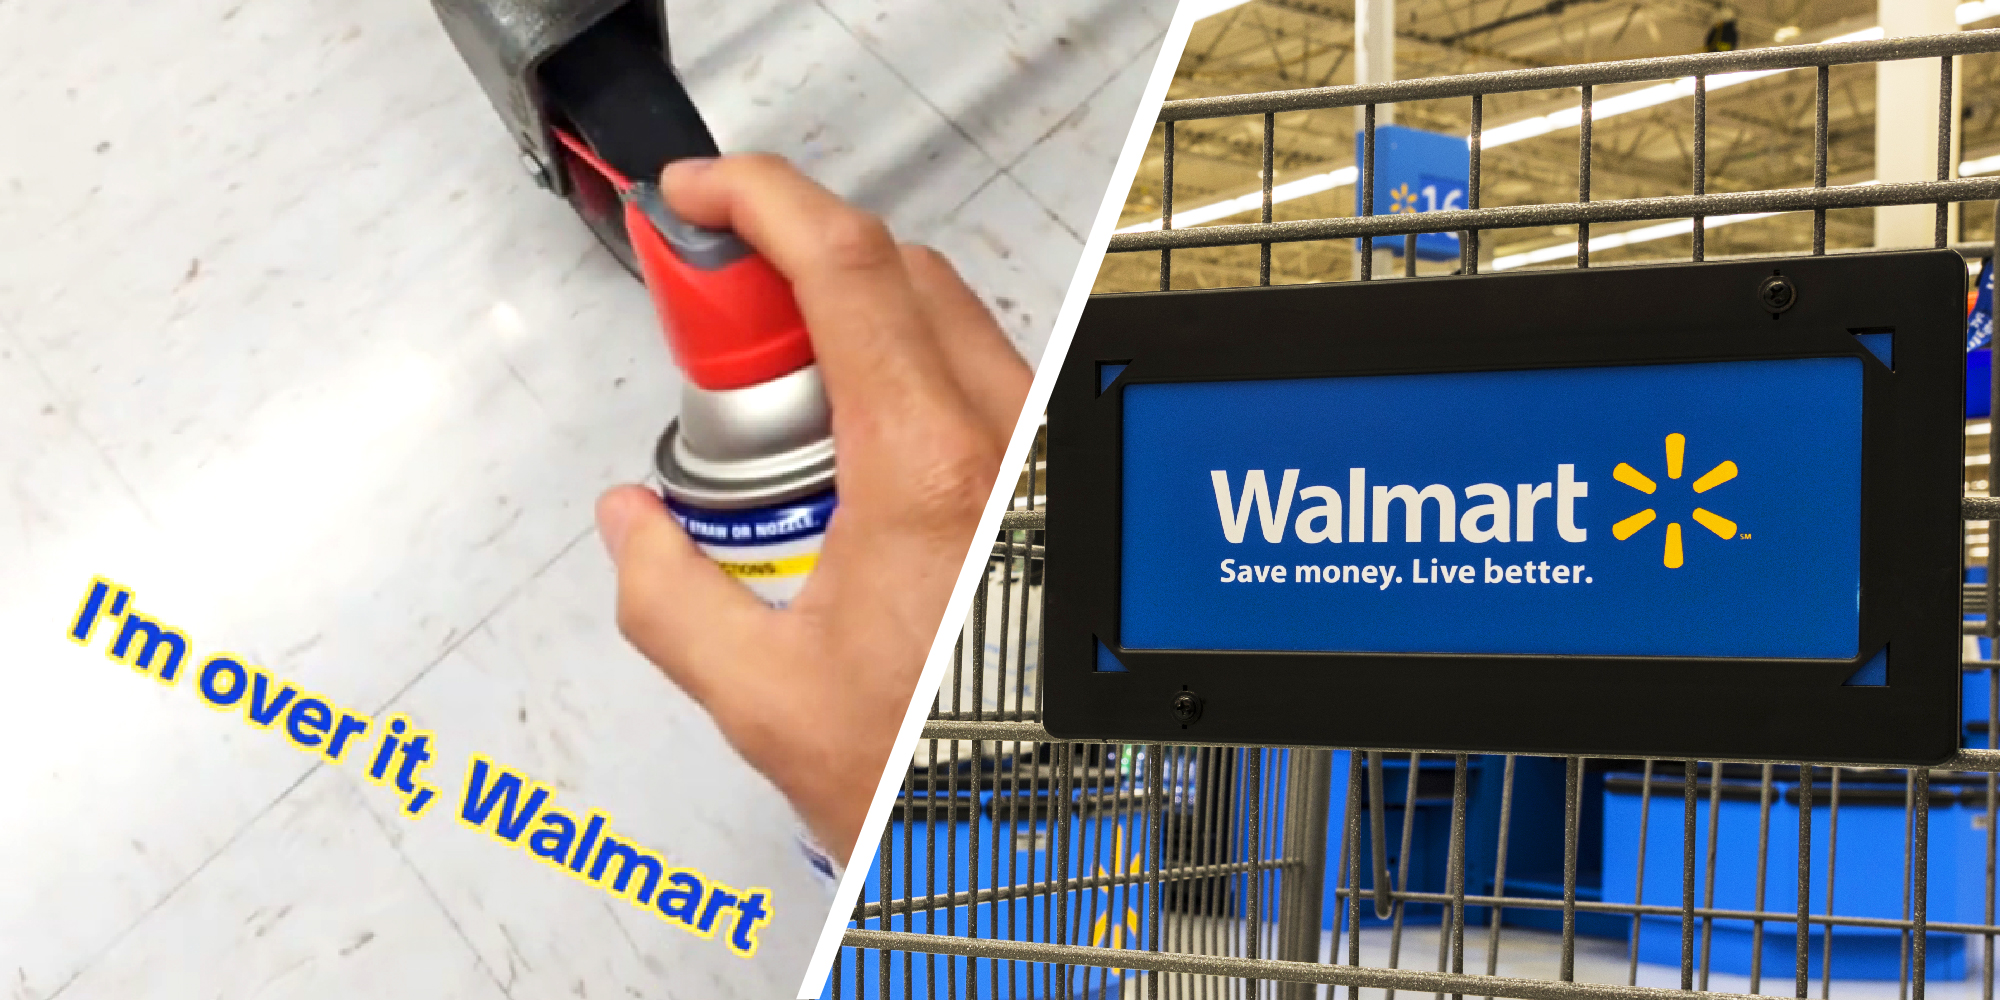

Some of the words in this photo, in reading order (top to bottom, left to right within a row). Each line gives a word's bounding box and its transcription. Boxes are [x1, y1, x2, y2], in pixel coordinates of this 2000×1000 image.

[1210, 463, 1589, 544] Walmart
[731, 522, 752, 539] OR
[1220, 558, 1287, 584] Save
[1294, 564, 1403, 591] money.
[1412, 557, 1476, 584] Live
[1484, 557, 1593, 584] better.
